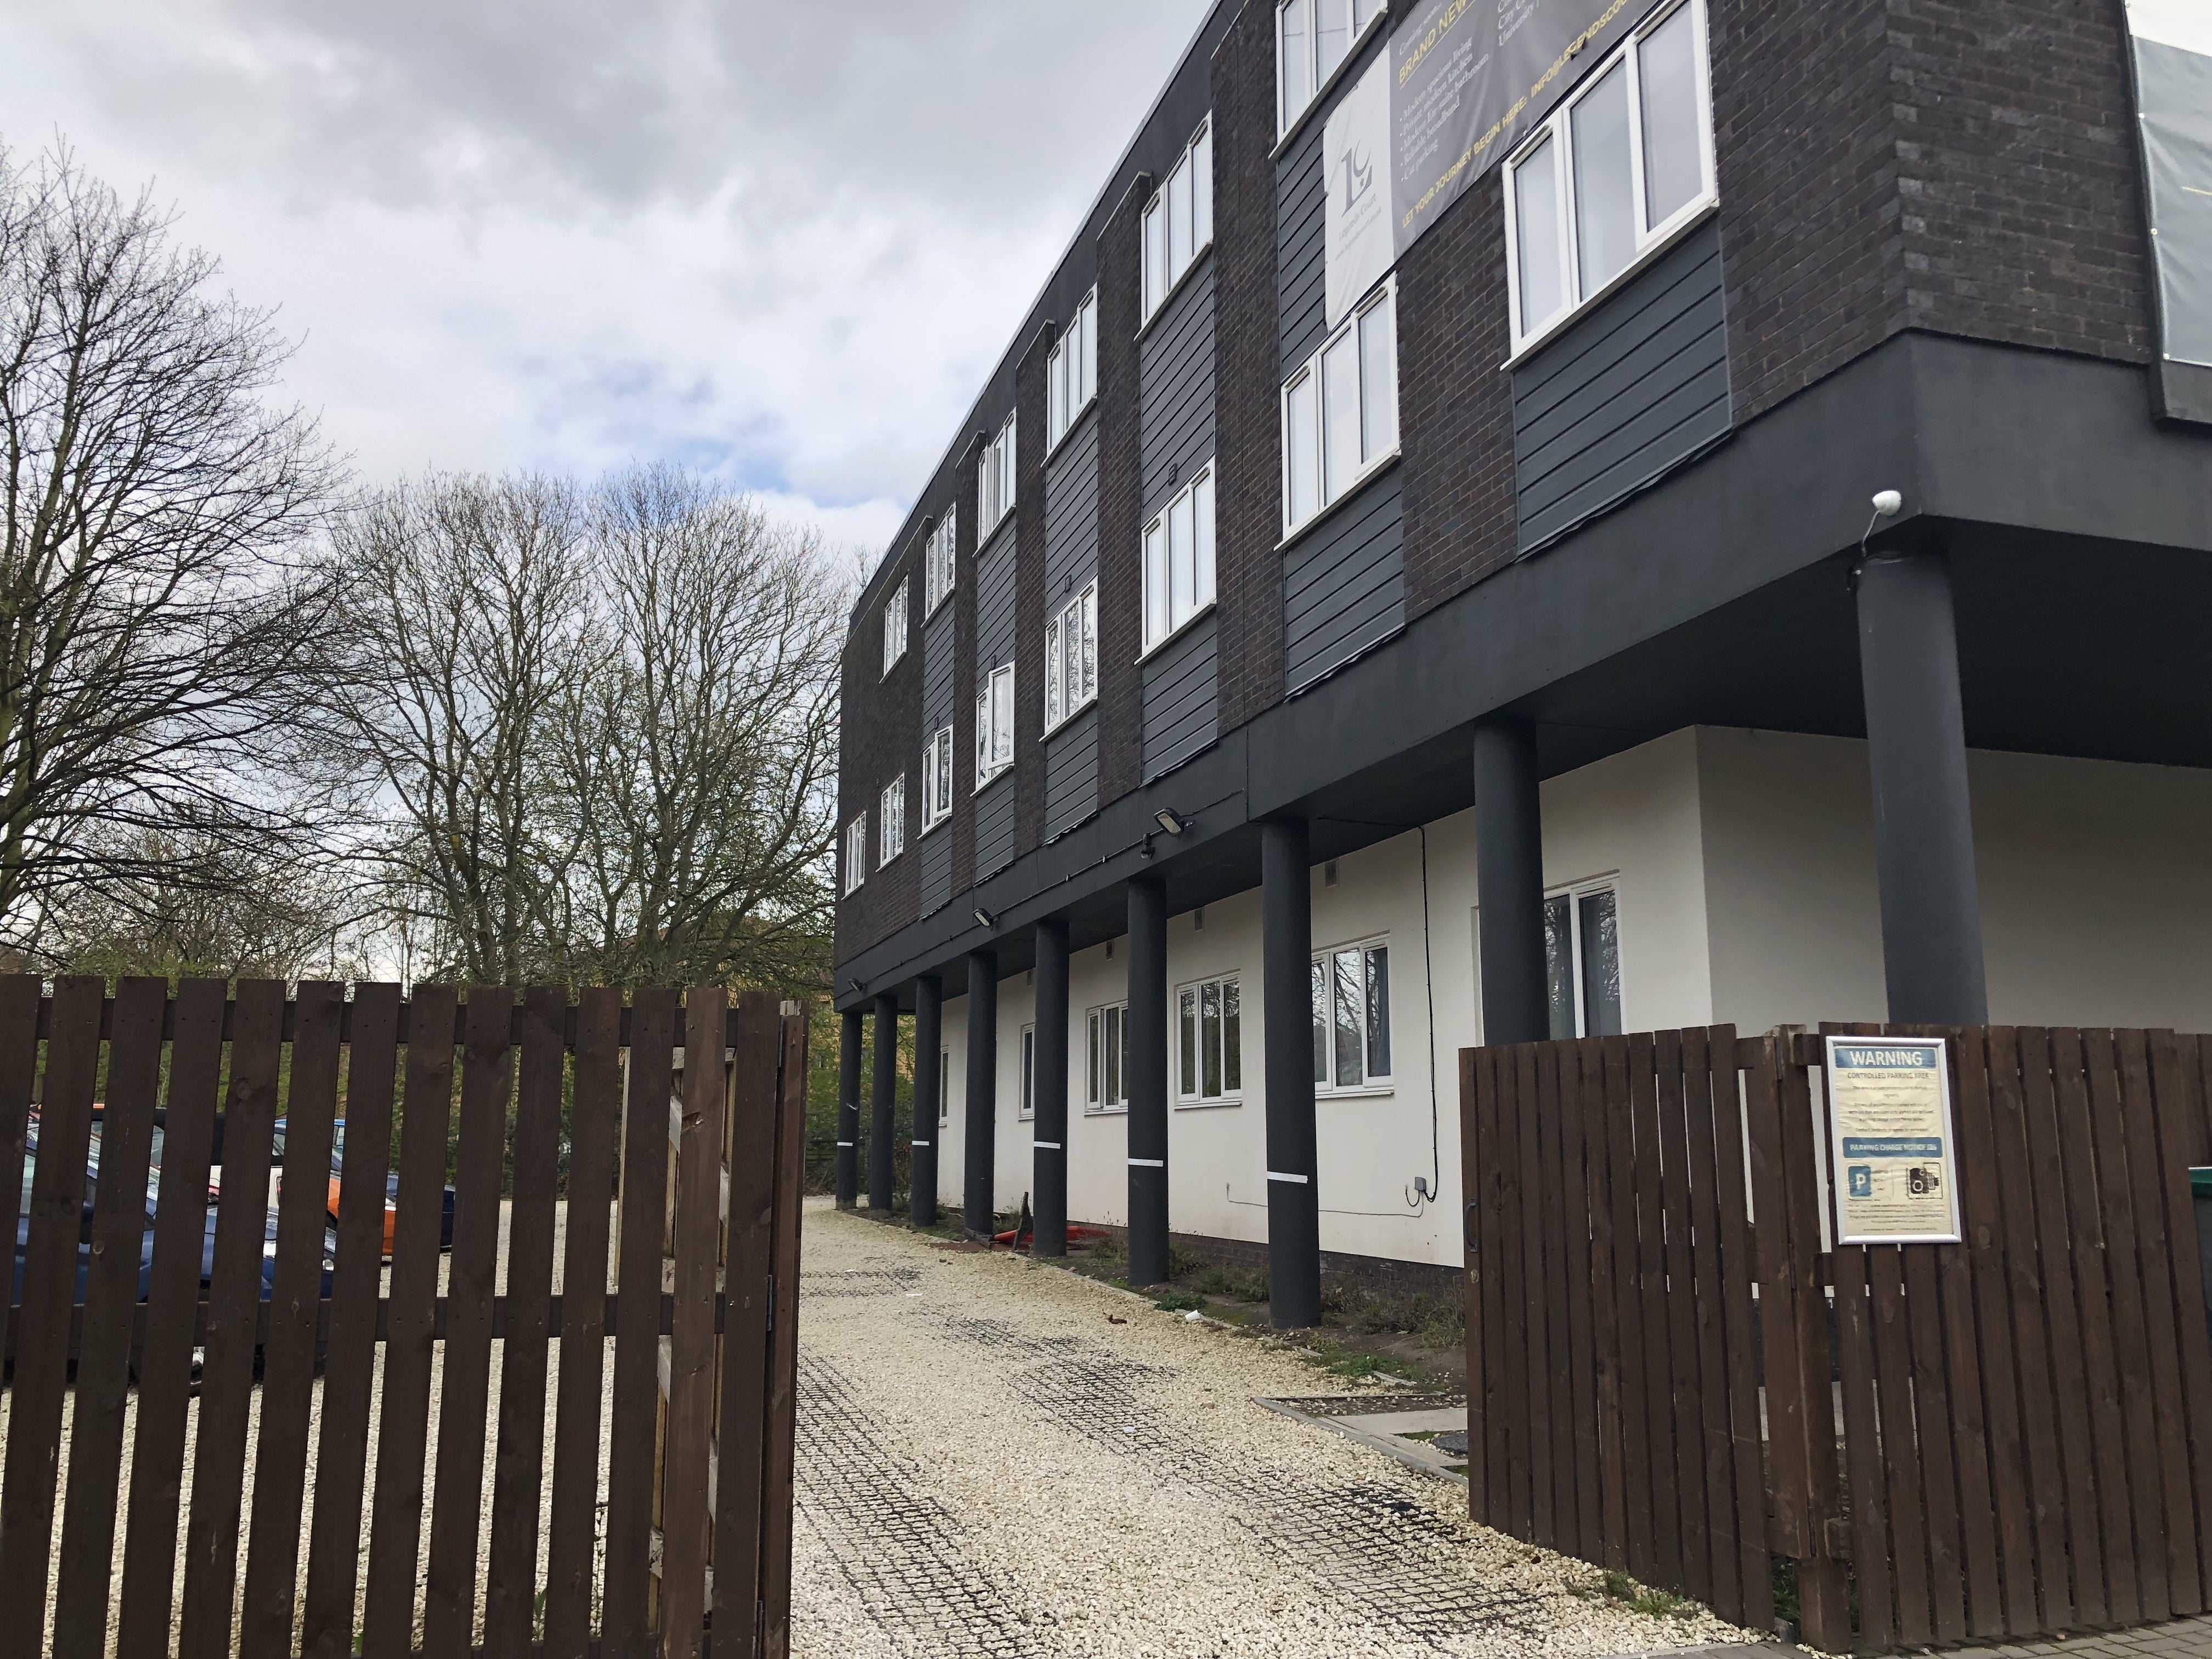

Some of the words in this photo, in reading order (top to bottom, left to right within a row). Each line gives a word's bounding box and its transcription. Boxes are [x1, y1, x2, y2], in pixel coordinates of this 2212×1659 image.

[1400, 28, 1435, 83] BRAND
[1439, 0, 1466, 34] NEW
[1403, 208, 1414, 228] LET
[1414, 187, 1435, 213] YOUR
[1435, 148, 1472, 193] JOURNEY
[1474, 121, 1500, 155] BEGIN
[1849, 1051, 1923, 1066] WARNING
